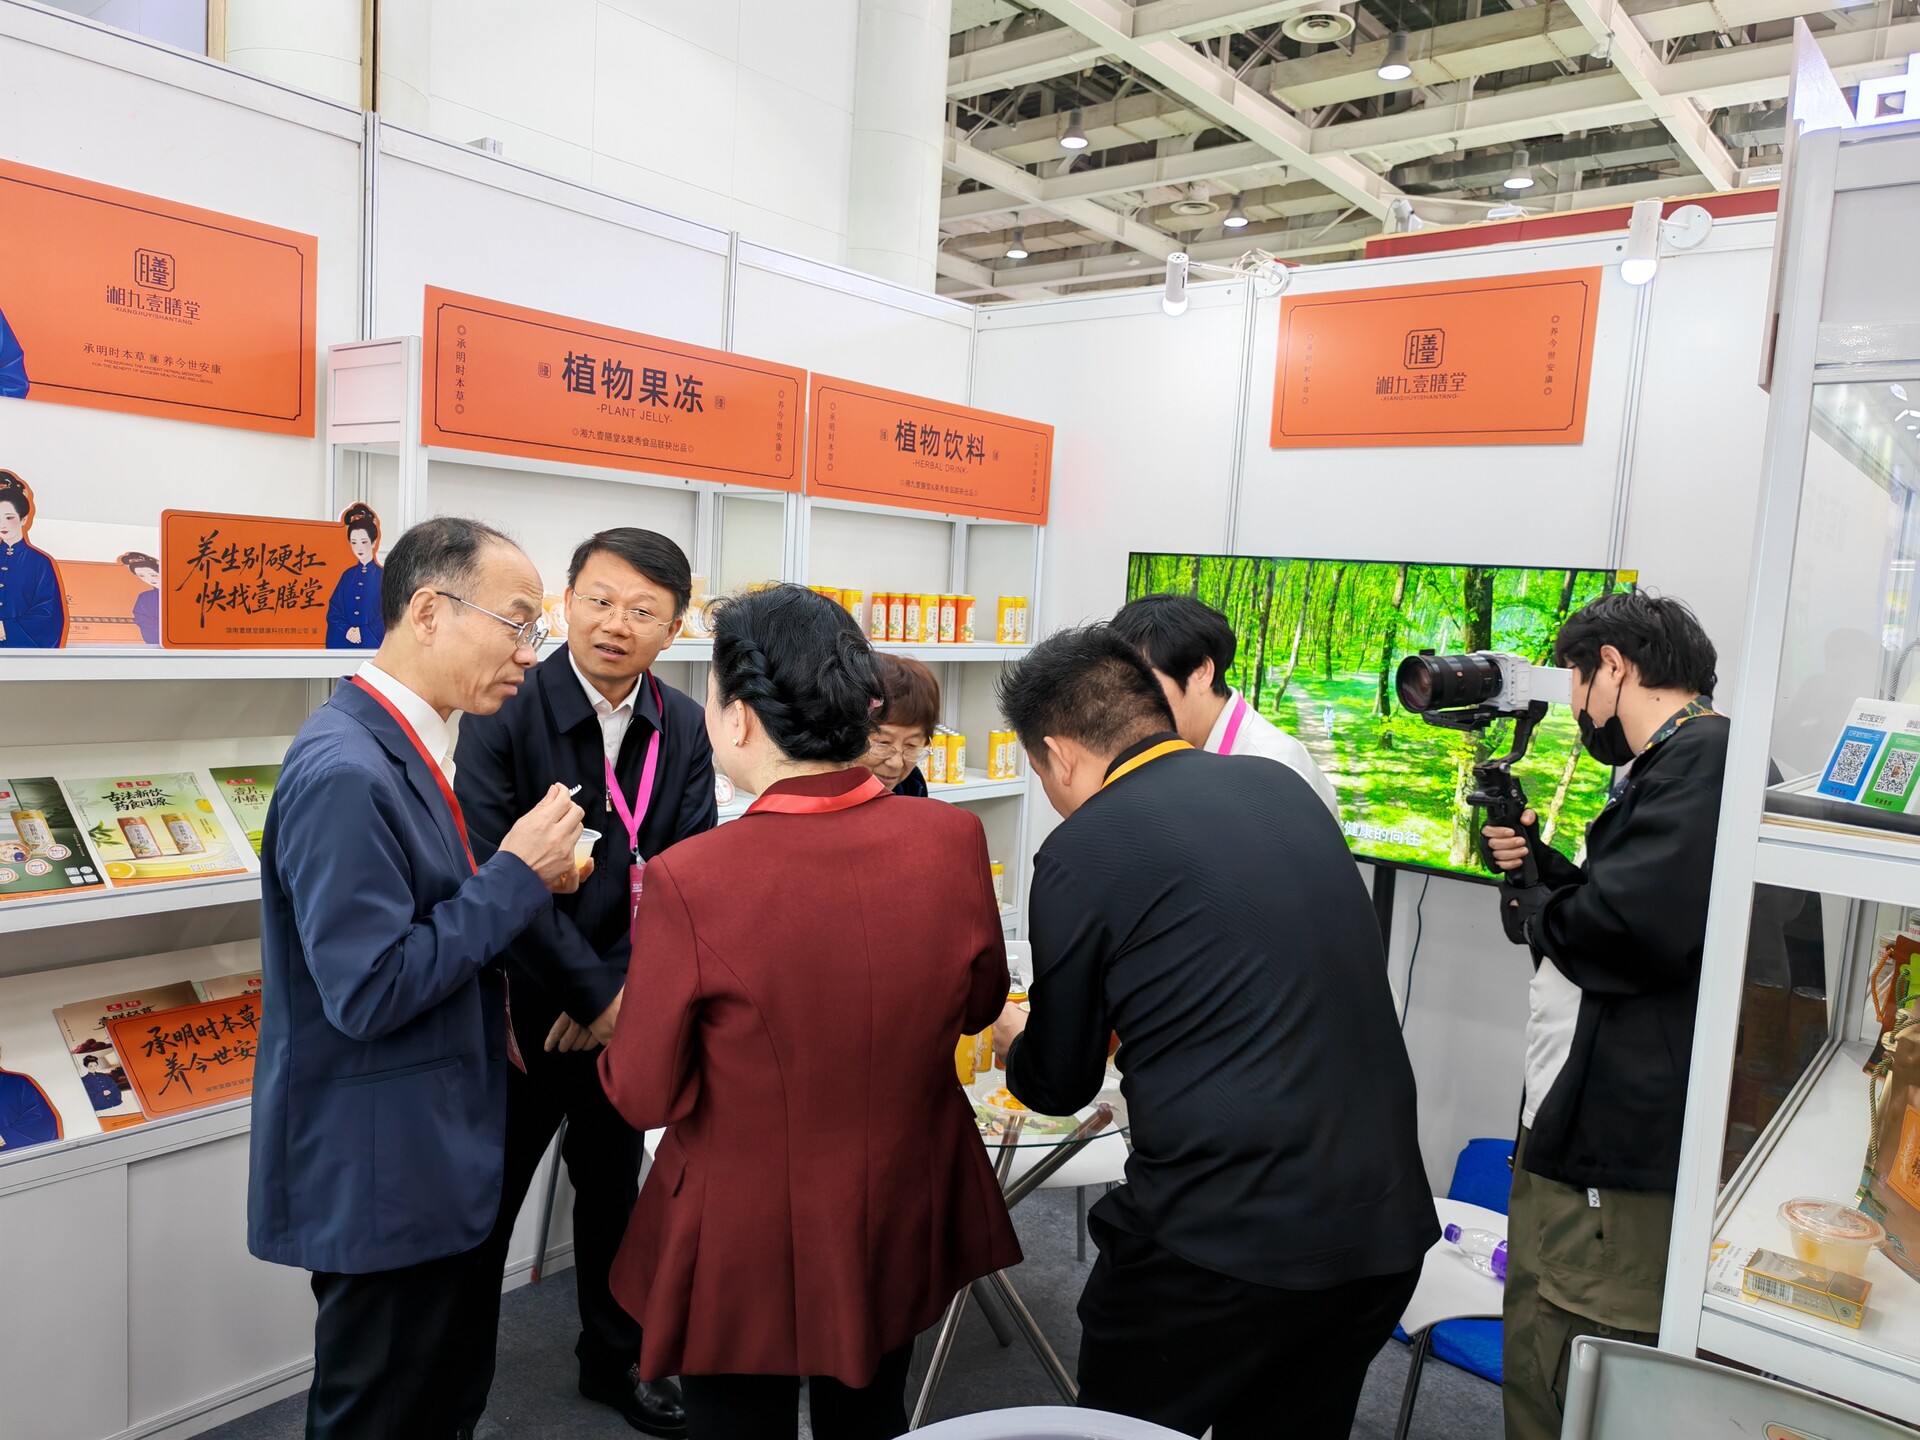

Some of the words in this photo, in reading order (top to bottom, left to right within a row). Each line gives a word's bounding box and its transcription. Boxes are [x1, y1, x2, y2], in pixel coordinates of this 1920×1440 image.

[106, 285, 201, 321] 湘九壹膳堂
[82, 342, 145, 362] 承明时本草
[163, 355, 222, 375] 养今世安康
[455, 338, 467, 402] 承明时本草
[561, 350, 705, 414] 植物果冻
[1375, 372, 1468, 395] 湘九壹膳堂
[894, 419, 986, 466] 植物饮料
[175, 529, 327, 592] 养生别硬扛
[196, 577, 325, 628] 快找壹膳堂
[101, 788, 177, 803] 古法新饮
[113, 796, 177, 812] 药食同源
[1340, 820, 1421, 847] 健康的向往
[141, 1004, 261, 1058] 承明时本草
[158, 1039, 259, 1096] 养今世安
